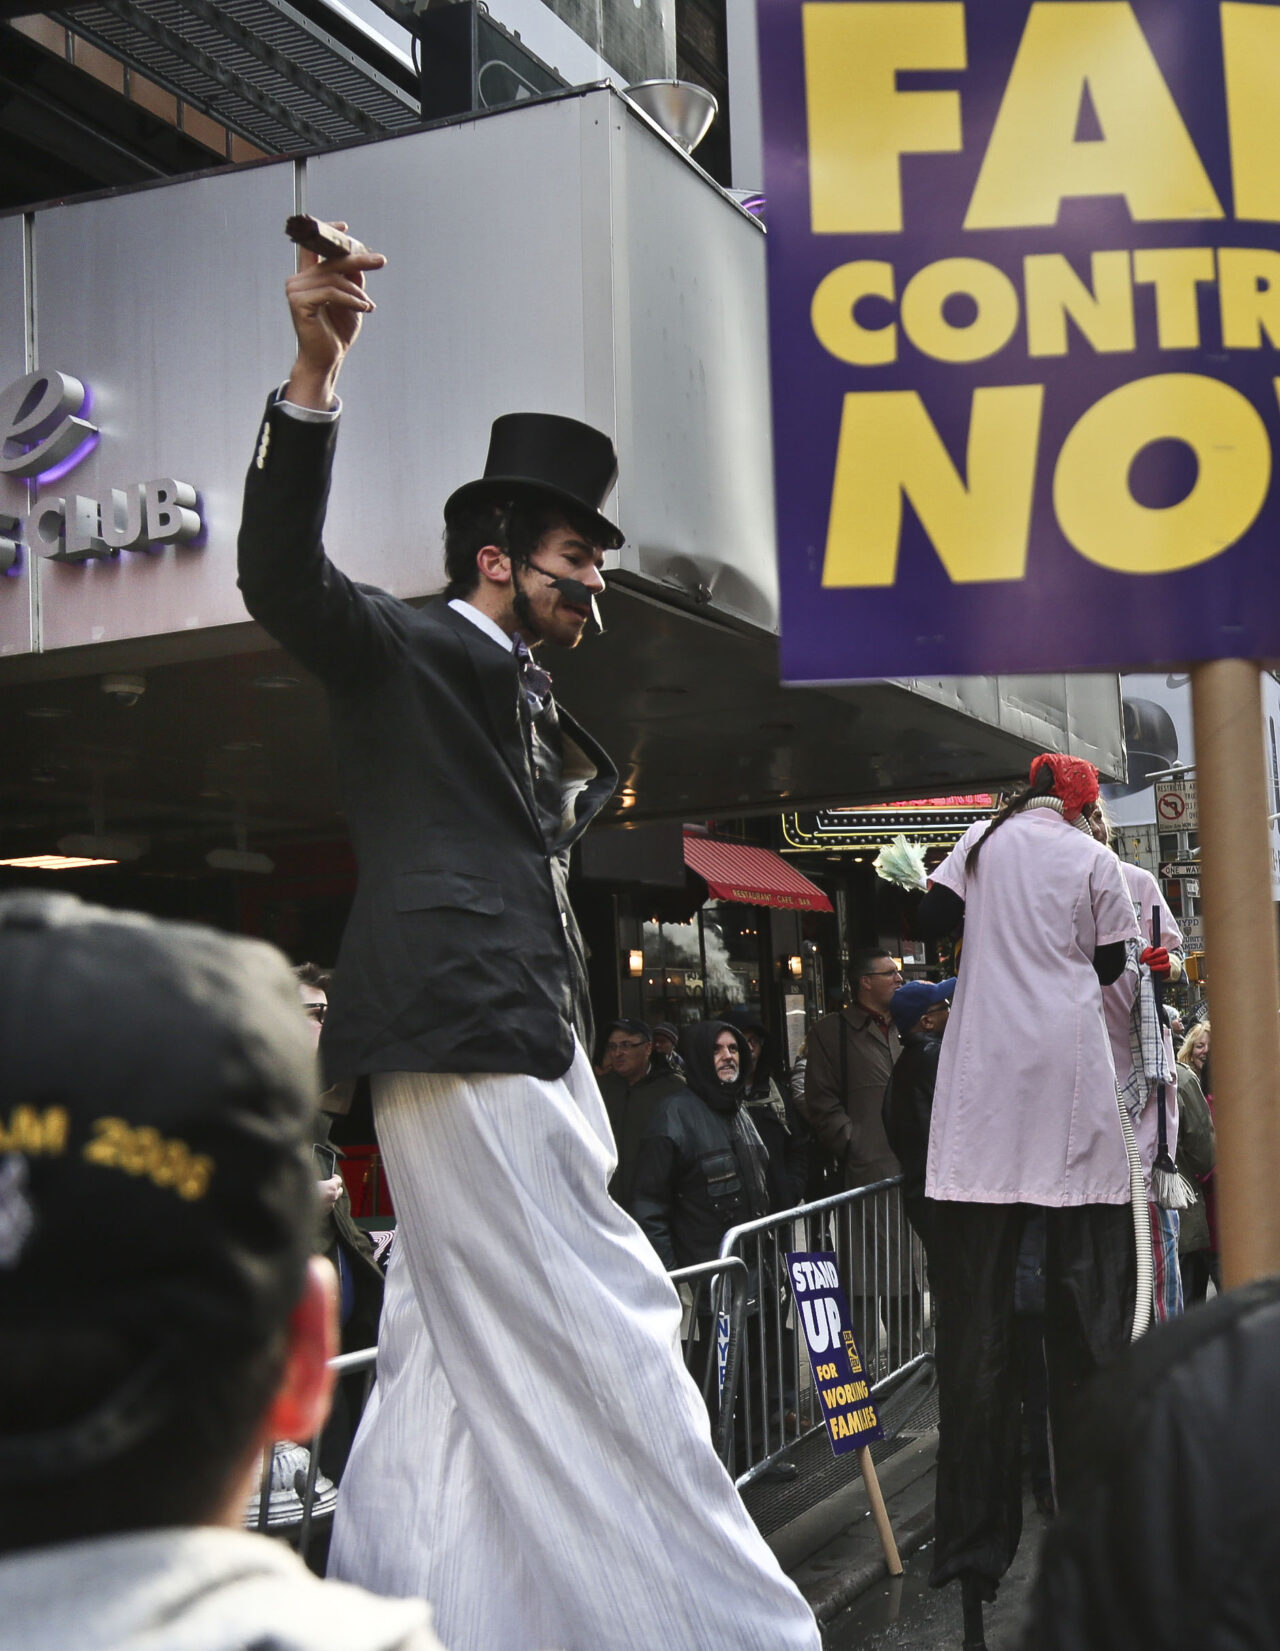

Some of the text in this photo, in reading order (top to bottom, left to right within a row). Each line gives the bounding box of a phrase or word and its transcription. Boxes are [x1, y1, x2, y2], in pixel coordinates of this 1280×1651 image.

[25, 477, 200, 561] CLUB
[1165, 864, 1200, 874] ONE WAY
[732, 889, 772, 902] RESTAURANT
[792, 1260, 839, 1292] STAND
[802, 1297, 842, 1353] UP
[816, 1362, 839, 1381] FOR
[822, 1379, 869, 1409] WORKING
[829, 1405, 877, 1440] FAMILIES
